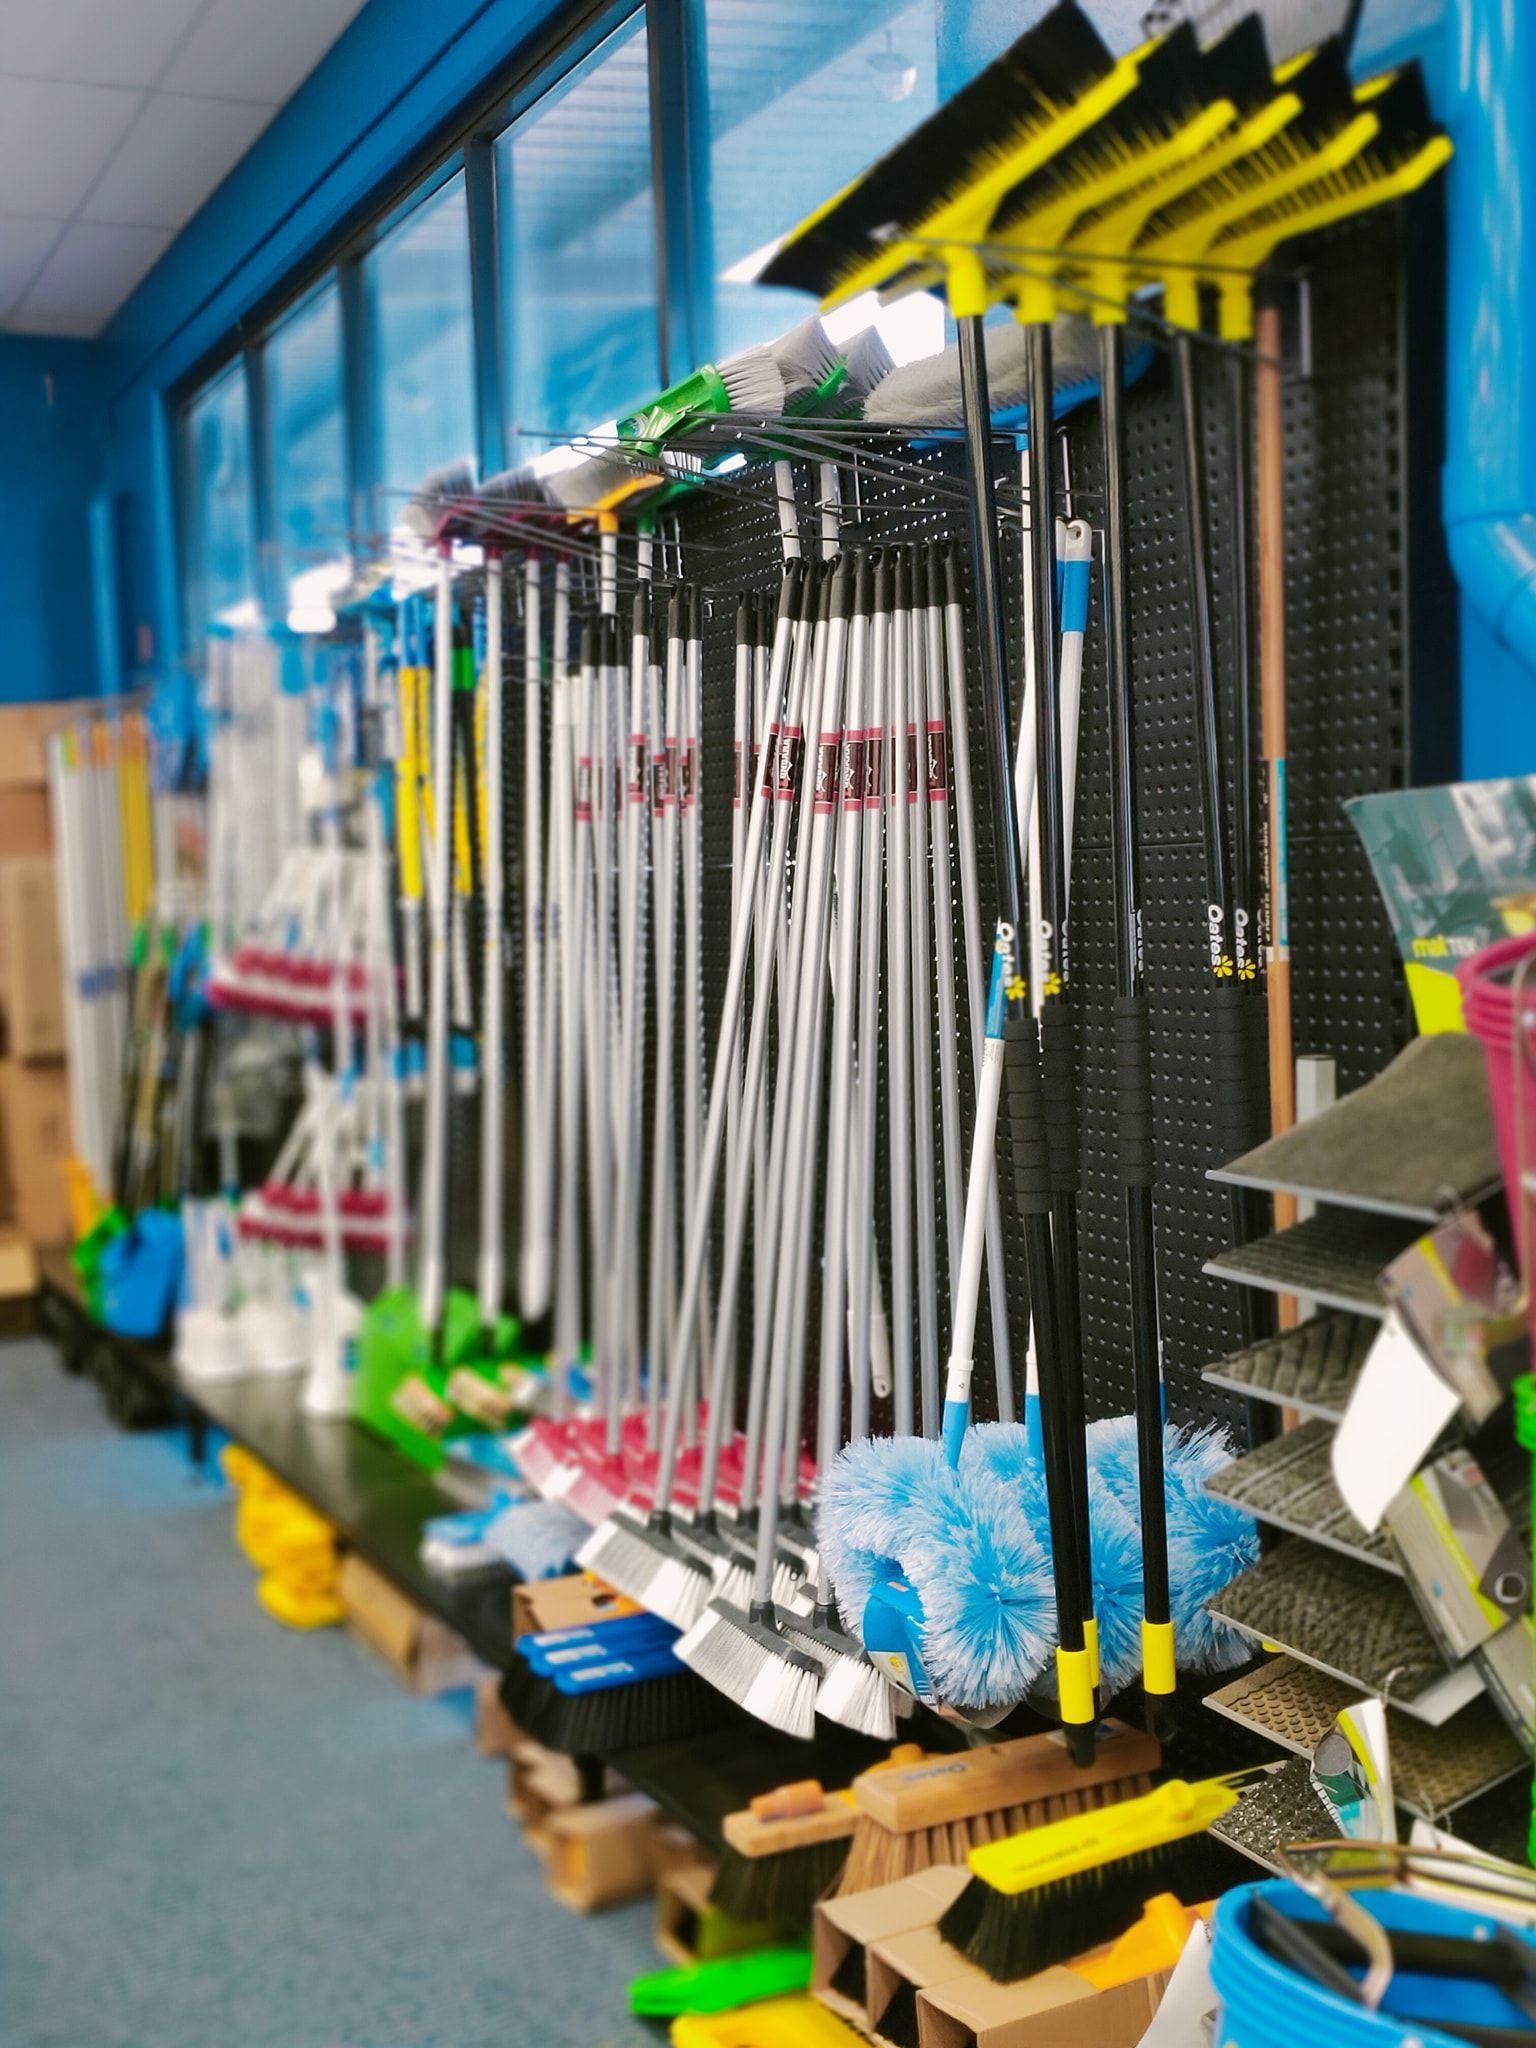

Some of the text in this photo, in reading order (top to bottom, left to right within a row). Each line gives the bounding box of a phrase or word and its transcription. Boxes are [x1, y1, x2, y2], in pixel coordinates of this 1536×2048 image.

[1000, 922, 1015, 987] Oates
[1208, 904, 1224, 966] Oates
[1235, 908, 1249, 969] Oates
